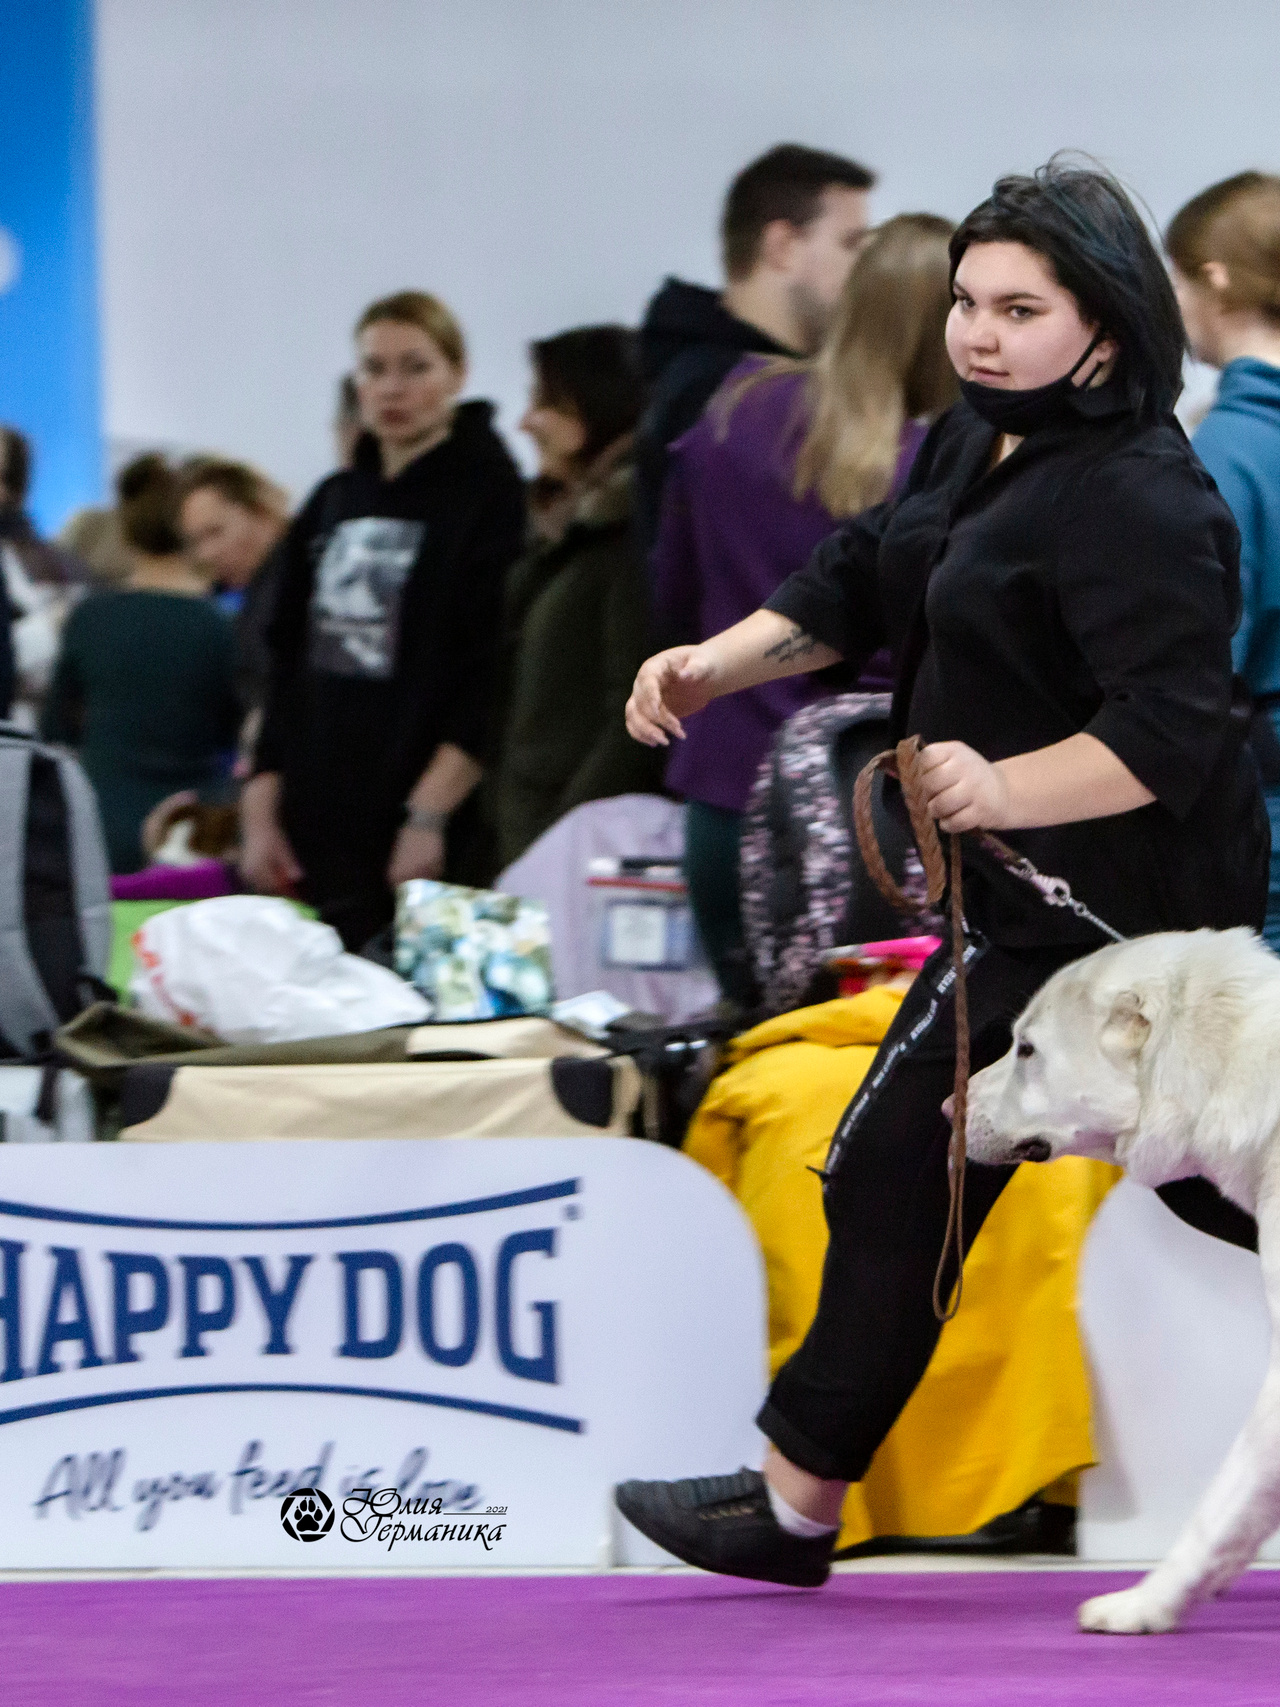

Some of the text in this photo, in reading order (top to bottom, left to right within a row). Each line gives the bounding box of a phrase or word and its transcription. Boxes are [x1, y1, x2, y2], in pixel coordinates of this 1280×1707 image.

[334, 1226, 559, 1385] DOG
[34, 1447, 126, 1520] All
[133, 1472, 218, 1532] you
[229, 1438, 336, 1515] feed
